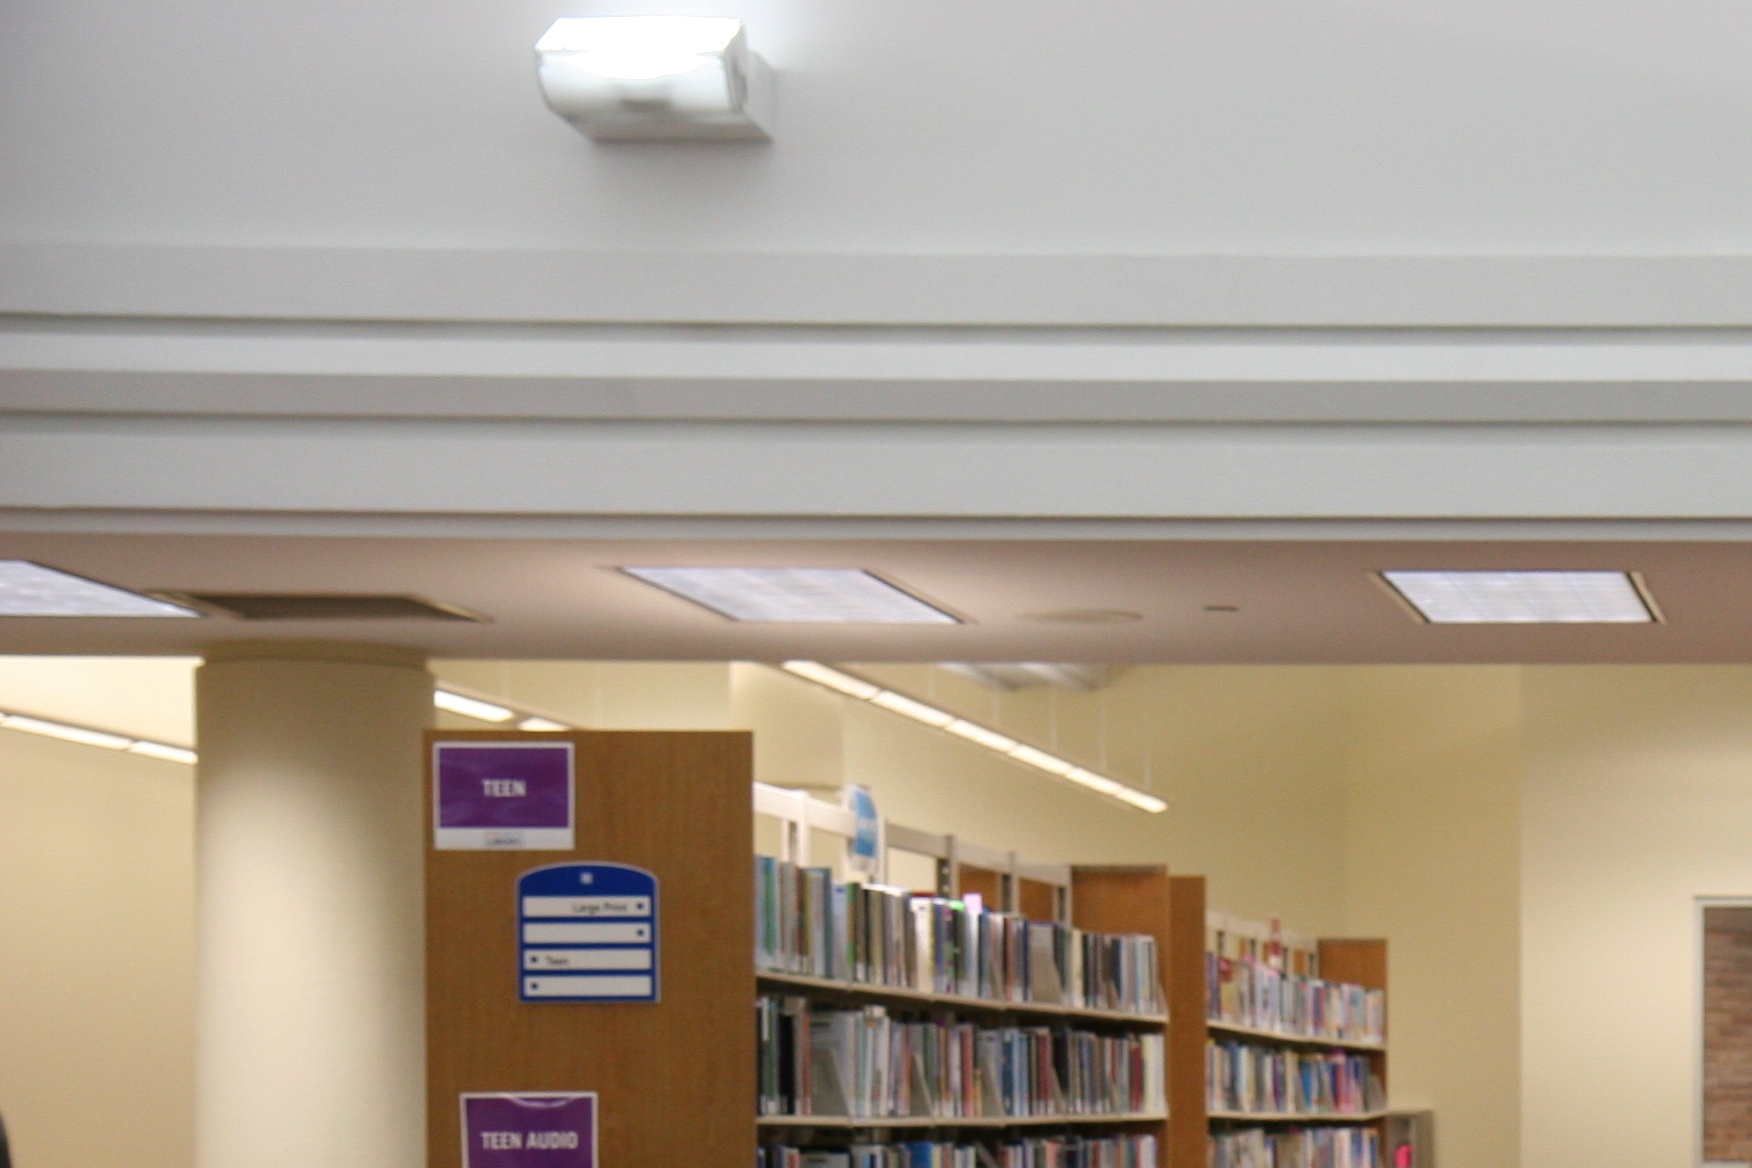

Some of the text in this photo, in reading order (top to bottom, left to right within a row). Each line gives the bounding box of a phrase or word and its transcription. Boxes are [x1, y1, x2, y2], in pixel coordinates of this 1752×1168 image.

[482, 779, 527, 798] TEEN
[572, 902, 628, 915] Large Print
[545, 955, 569, 967] Teen
[480, 1130, 579, 1150] TEEN AUDIO
